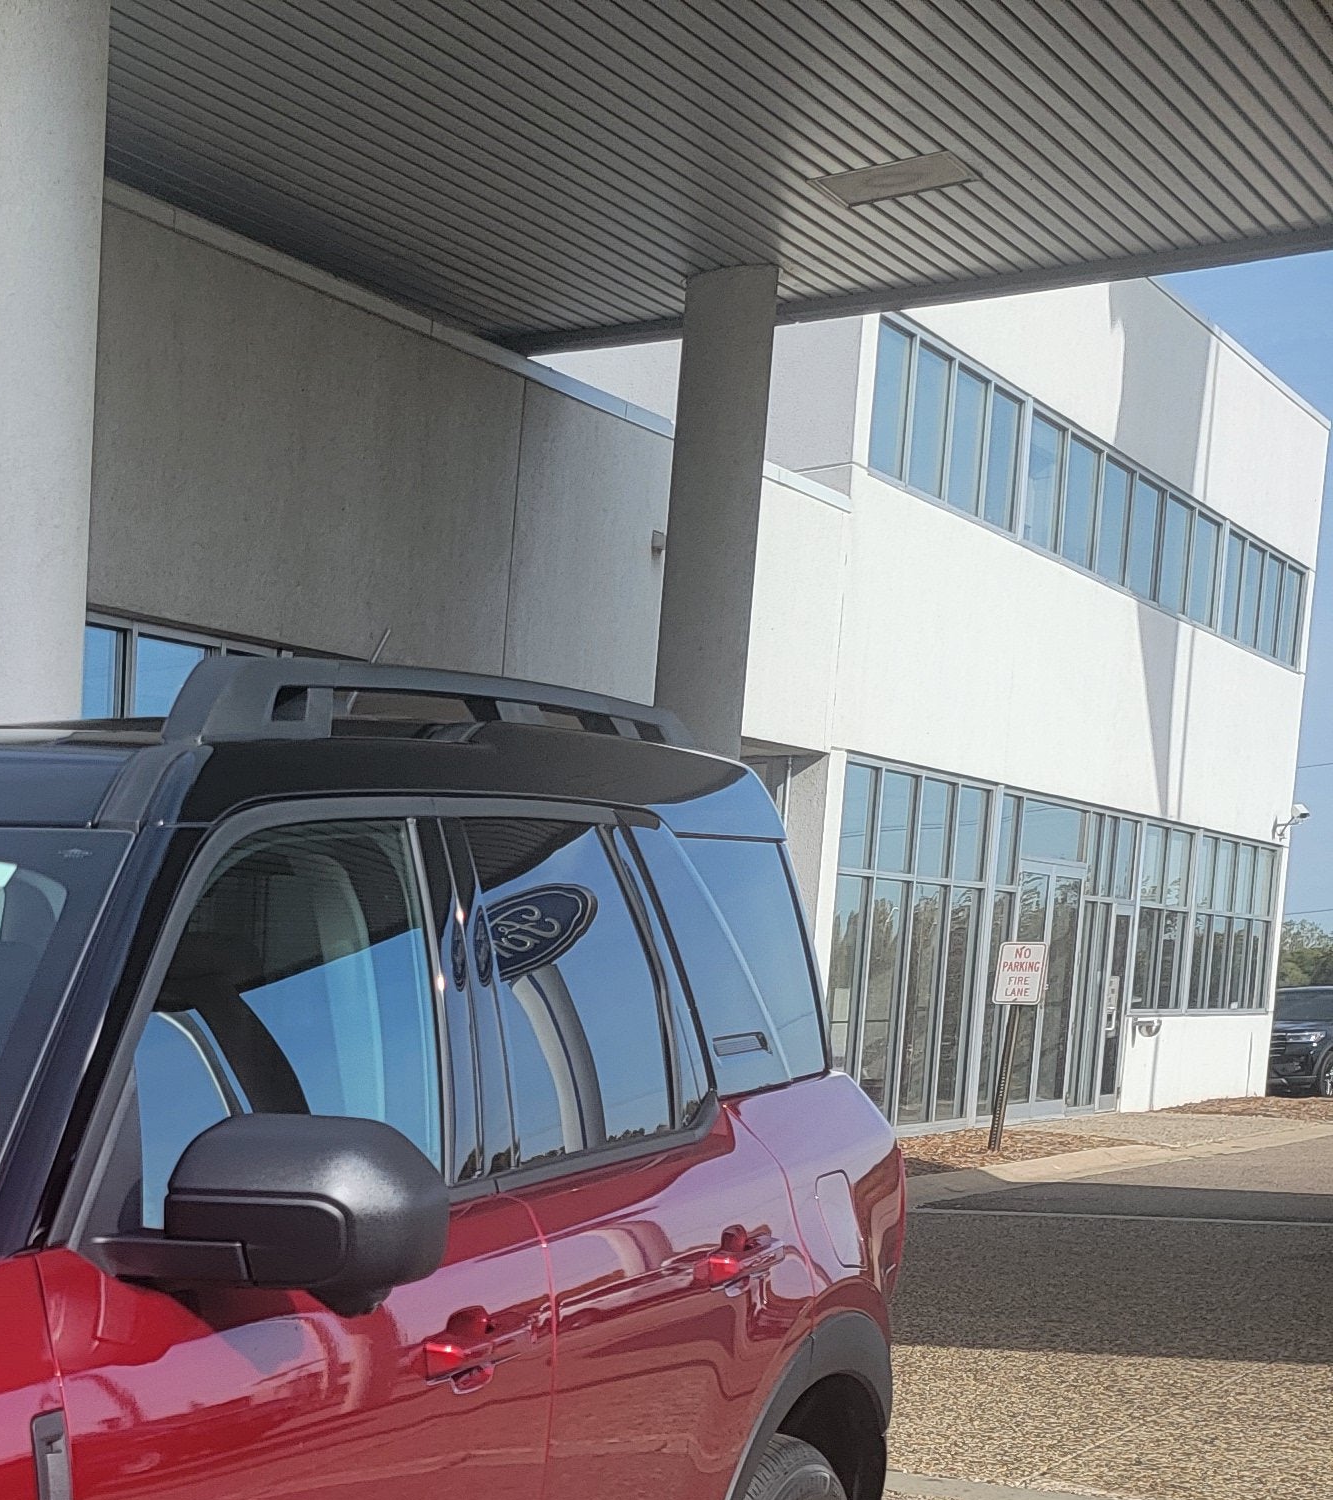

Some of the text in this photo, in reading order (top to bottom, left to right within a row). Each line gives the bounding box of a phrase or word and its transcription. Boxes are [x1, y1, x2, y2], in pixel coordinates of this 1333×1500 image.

[1014, 948, 1031, 959] NO
[1002, 961, 1040, 973] PARKING
[1008, 977, 1030, 986] FIRE
[1005, 987, 1030, 997] LANE
